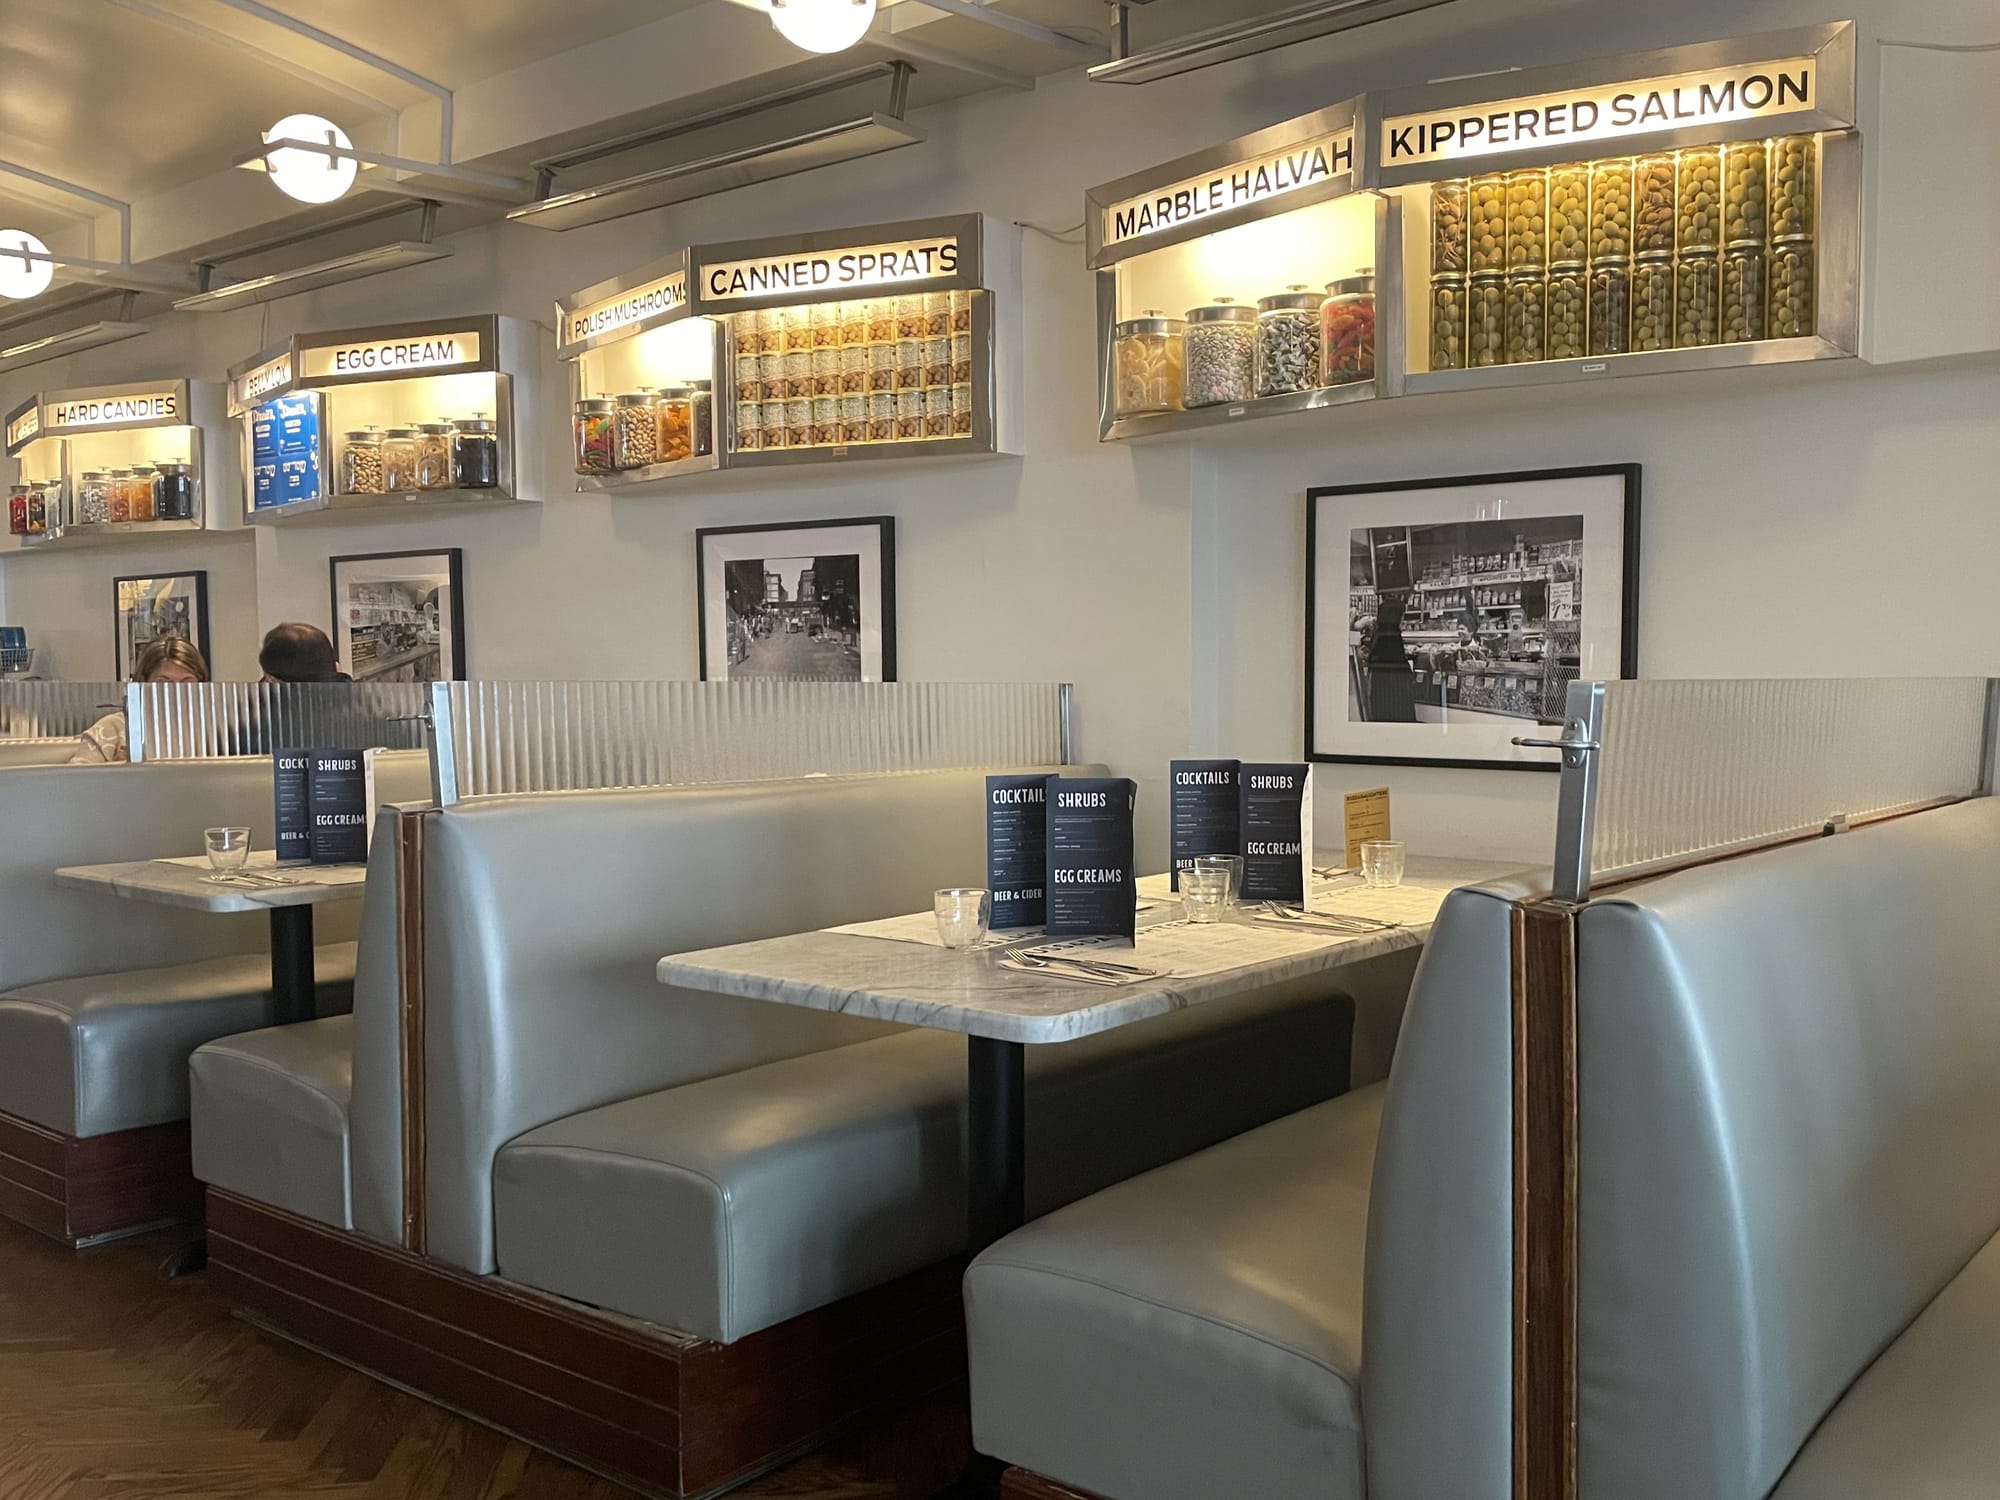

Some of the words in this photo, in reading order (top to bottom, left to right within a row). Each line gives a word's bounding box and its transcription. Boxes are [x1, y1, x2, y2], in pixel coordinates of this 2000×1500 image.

[1390, 100, 1599, 158] KIPPERED
[1611, 70, 1809, 126] SALMON
[1115, 178, 1223, 240] MARBLE
[1231, 136, 1352, 203] HALVAH
[710, 259, 830, 296] CANNED
[838, 243, 957, 282] SPRATS
[575, 307, 612, 338] POLISH
[336, 348, 376, 370] EGG
[380, 340, 454, 365] CREAM
[57, 403, 99, 424] HARD
[103, 397, 176, 419] CANDIES
[318, 759, 357, 771] SHRUBS
[1176, 771, 1230, 785] COCKTAILS
[1250, 775, 1293, 789] SHRUBS
[992, 788, 1046, 804] COCKTAIL
[1057, 792, 1106, 808] SHRUBS
[316, 814, 332, 826] EGG
[281, 831, 297, 840] BEER
[1247, 842, 1264, 855] EGG
[1176, 859, 1193, 868] BEER
[1054, 869, 1074, 884] EGG
[1077, 868, 1122, 884] CREAMS
[994, 890, 1012, 902] BEER
[1013, 891, 1020, 900] &
[1021, 888, 1042, 900] CIDER
